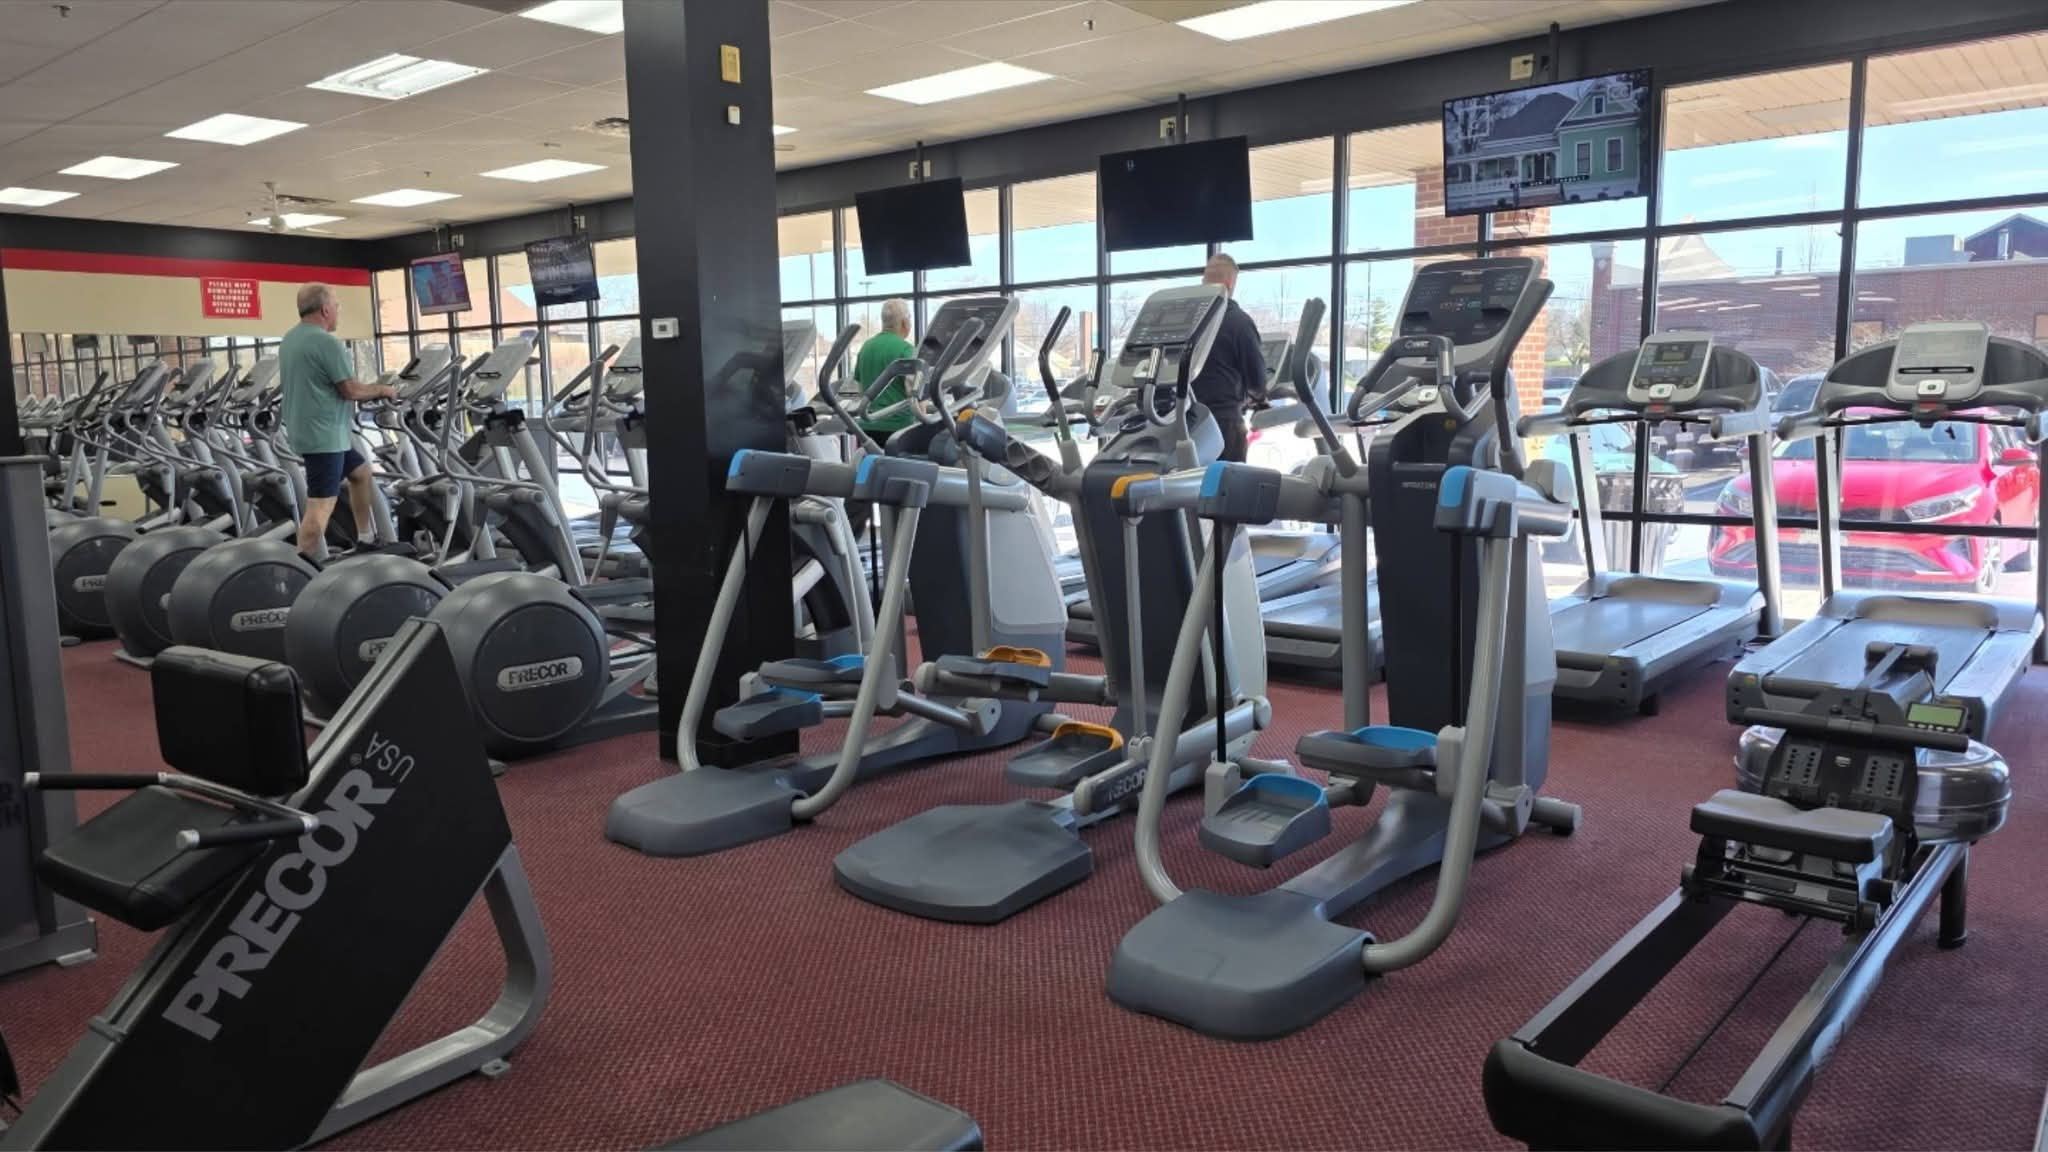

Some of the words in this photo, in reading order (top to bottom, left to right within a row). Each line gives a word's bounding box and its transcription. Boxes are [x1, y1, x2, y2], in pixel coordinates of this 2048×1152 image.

[240, 611, 288, 626] PRECO
[508, 662, 568, 685] PRECOR
[365, 731, 415, 783] USA
[162, 769, 397, 1041] PRECOR
